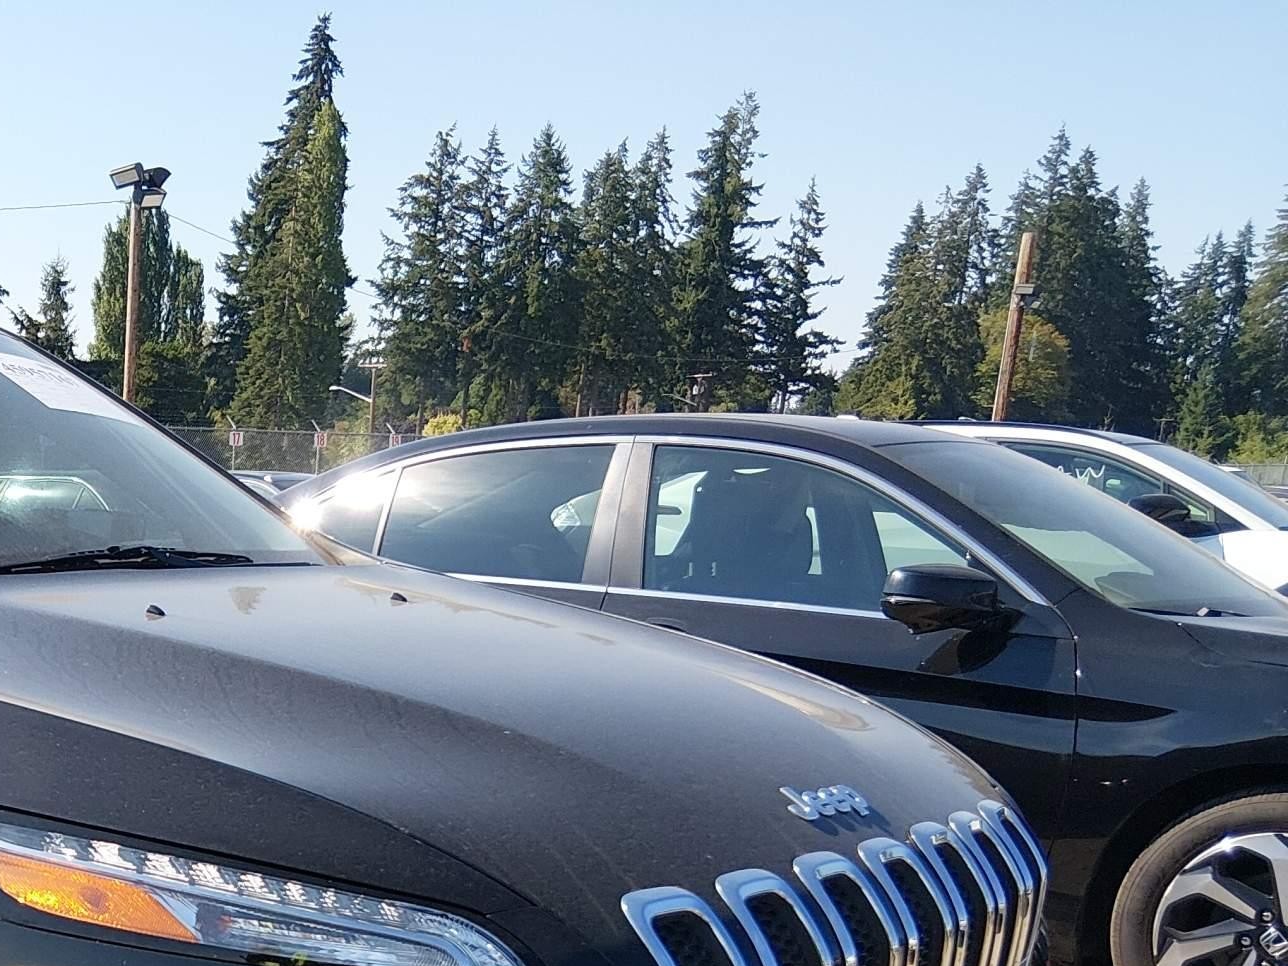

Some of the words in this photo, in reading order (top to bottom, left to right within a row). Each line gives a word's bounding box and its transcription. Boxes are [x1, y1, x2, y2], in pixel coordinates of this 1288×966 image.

[232, 432, 241, 446] 17
[316, 432, 325, 447] 18
[779, 785, 870, 820] Jeep
